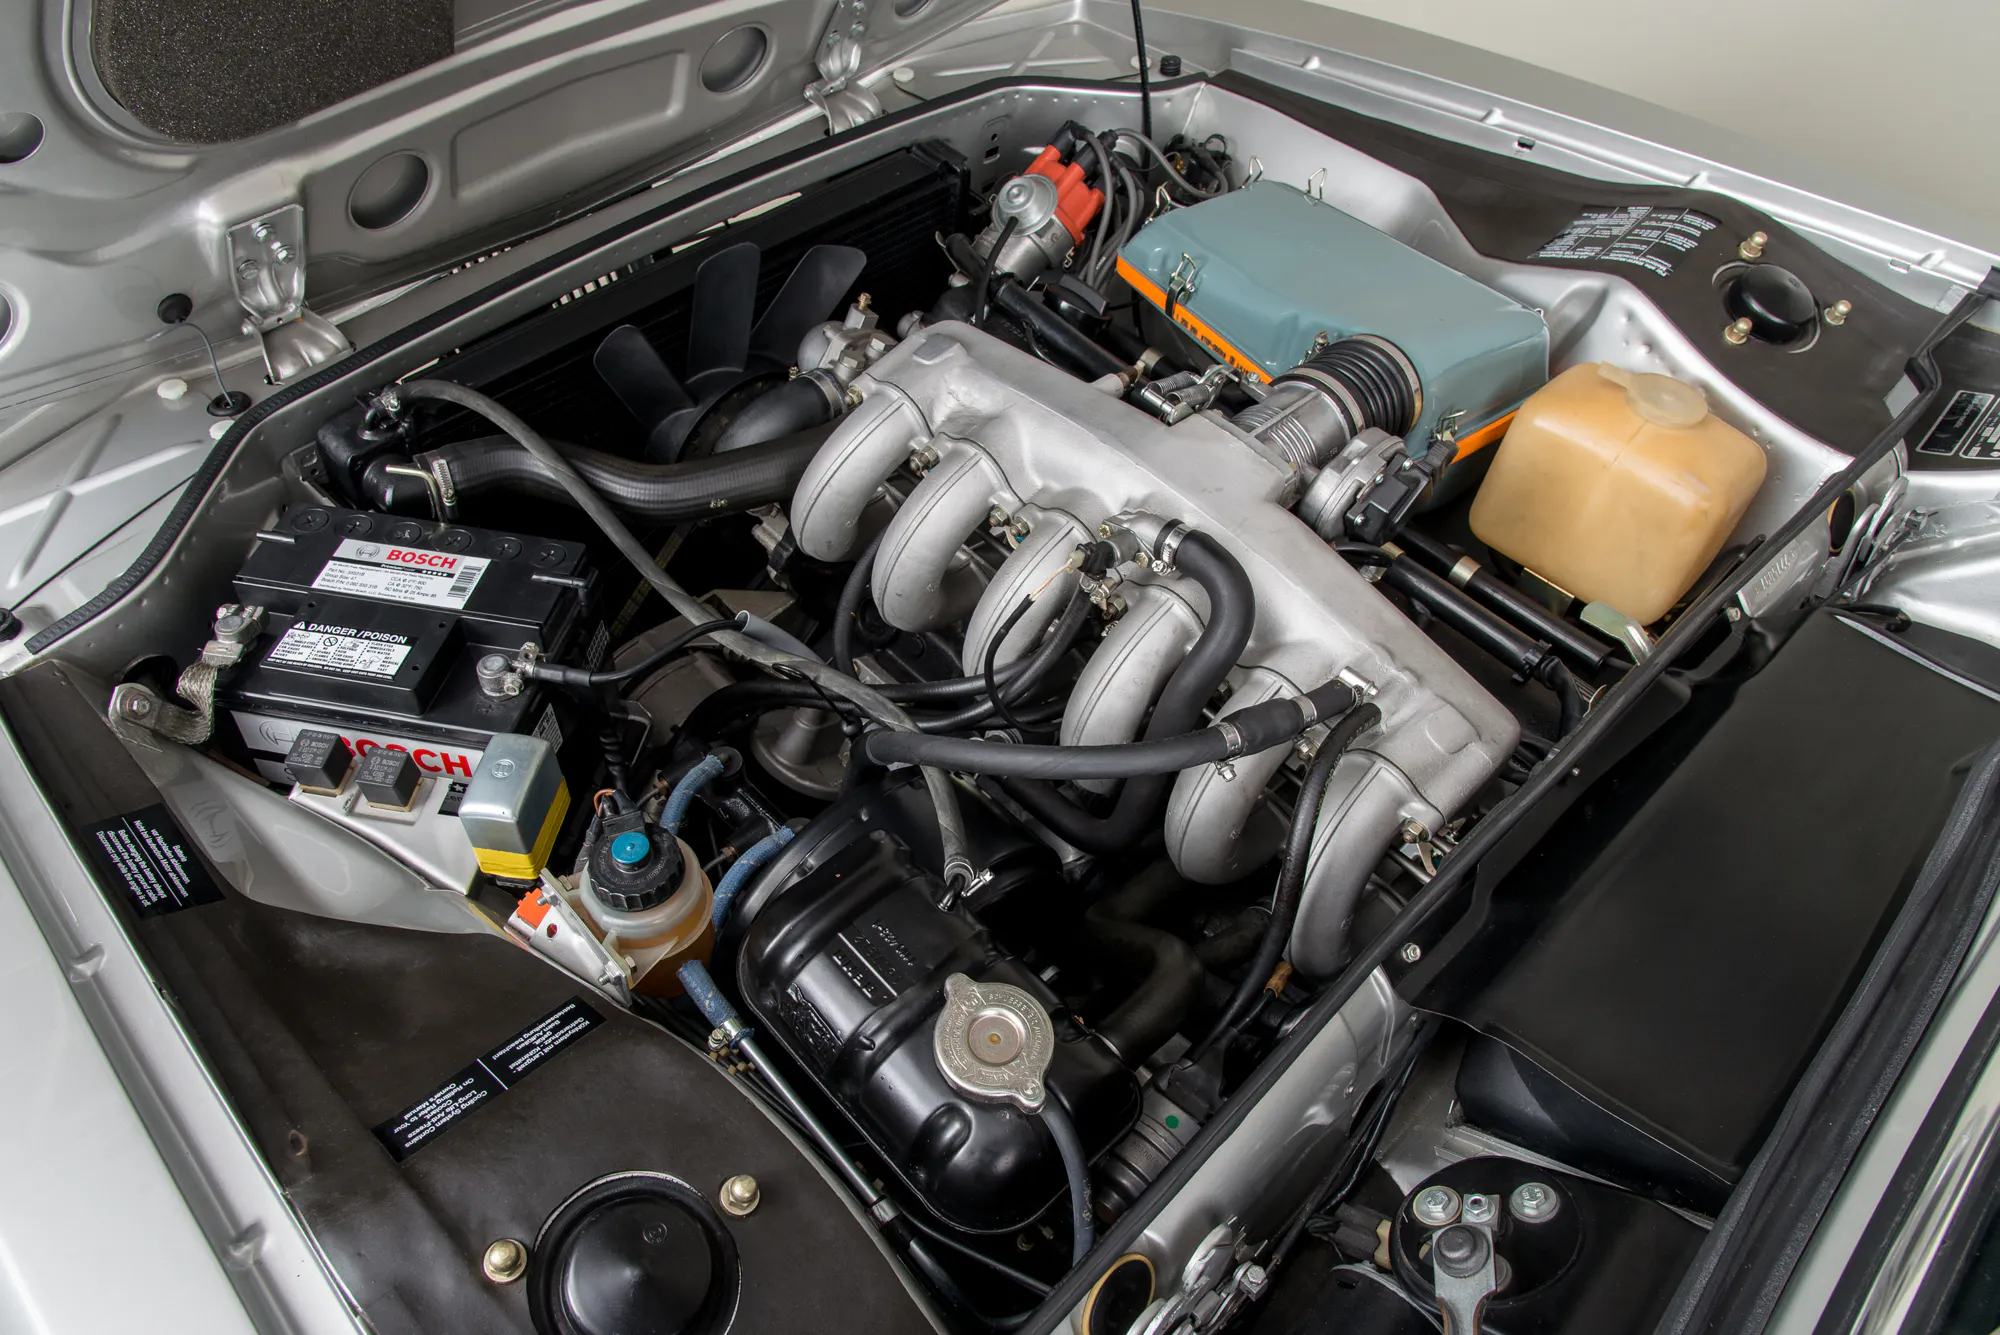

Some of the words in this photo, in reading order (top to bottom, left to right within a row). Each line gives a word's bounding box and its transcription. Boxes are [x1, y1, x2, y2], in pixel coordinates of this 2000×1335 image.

[386, 549, 457, 569] BOSCH
[307, 623, 357, 637] DANGER
[310, 741, 329, 749] BOSCH
[381, 759, 400, 767] BOSCH
[96, 831, 115, 853] Disconnect
[109, 853, 121, 862] only
[116, 862, 128, 872] while
[127, 880, 143, 894] engine
[106, 830, 125, 851] disconnect
[124, 859, 139, 873] battery
[134, 873, 149, 889] ground
[117, 830, 131, 843] Before
[124, 843, 143, 861] charging
[141, 868, 157, 883] battery
[151, 883, 168, 897] always
[543, 1020, 559, 1031] Beim
[462, 1077, 473, 1085] On
[428, 1083, 456, 1101] Owner's
[435, 1085, 463, 1104] Refilling
[444, 1090, 476, 1112] Long-Life
[460, 1090, 487, 1109] Cooling
[403, 1101, 429, 1119] Manual
[417, 1103, 436, 1116] Refer
[434, 1108, 461, 1126] System
[393, 1121, 410, 1133] Your
[407, 1111, 445, 1138] Anti-Freeze
[404, 1126, 435, 1148] Contains
